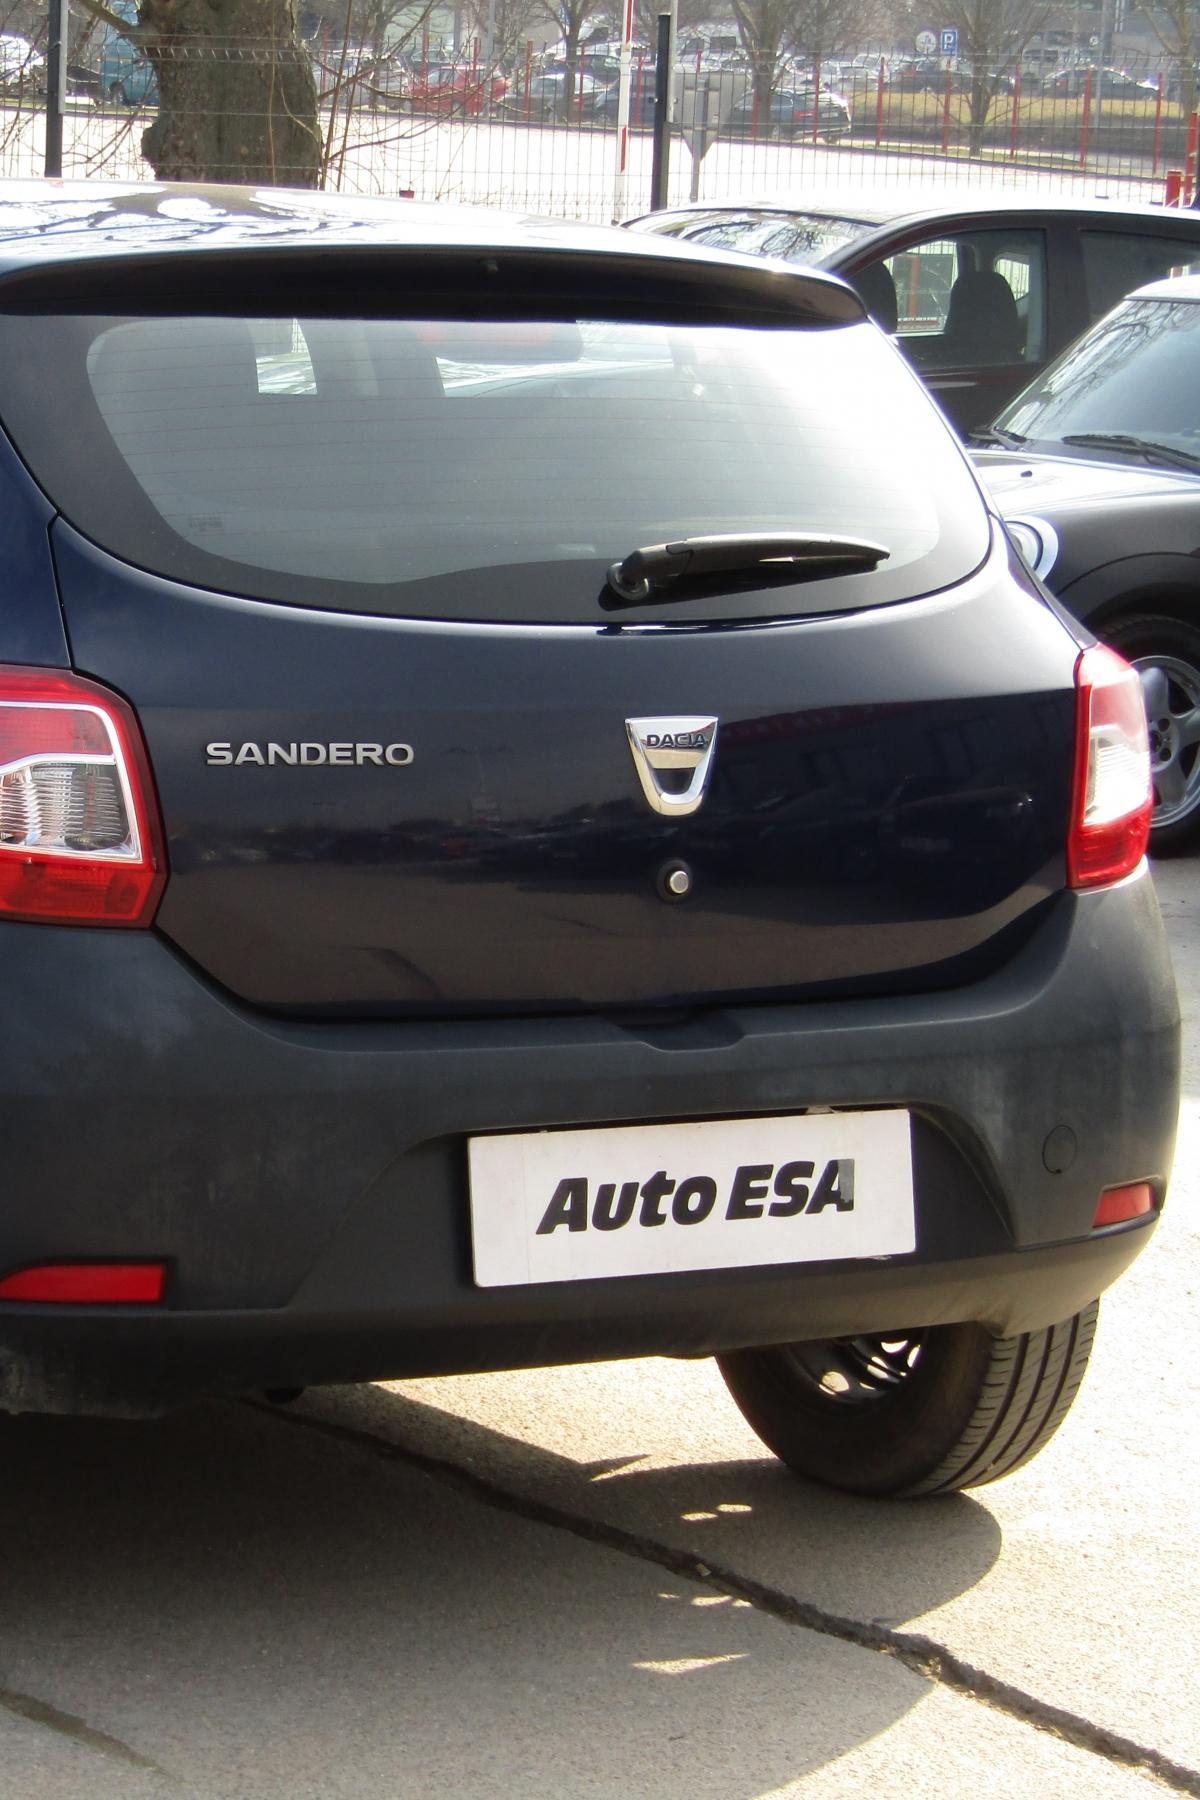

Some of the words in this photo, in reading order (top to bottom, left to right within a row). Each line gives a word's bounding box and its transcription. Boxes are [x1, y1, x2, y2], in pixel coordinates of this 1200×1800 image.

[646, 733, 706, 748] DACIA
[206, 742, 414, 765] SANDERO
[535, 1171, 717, 1235] Auto
[725, 1158, 855, 1221] ESA
